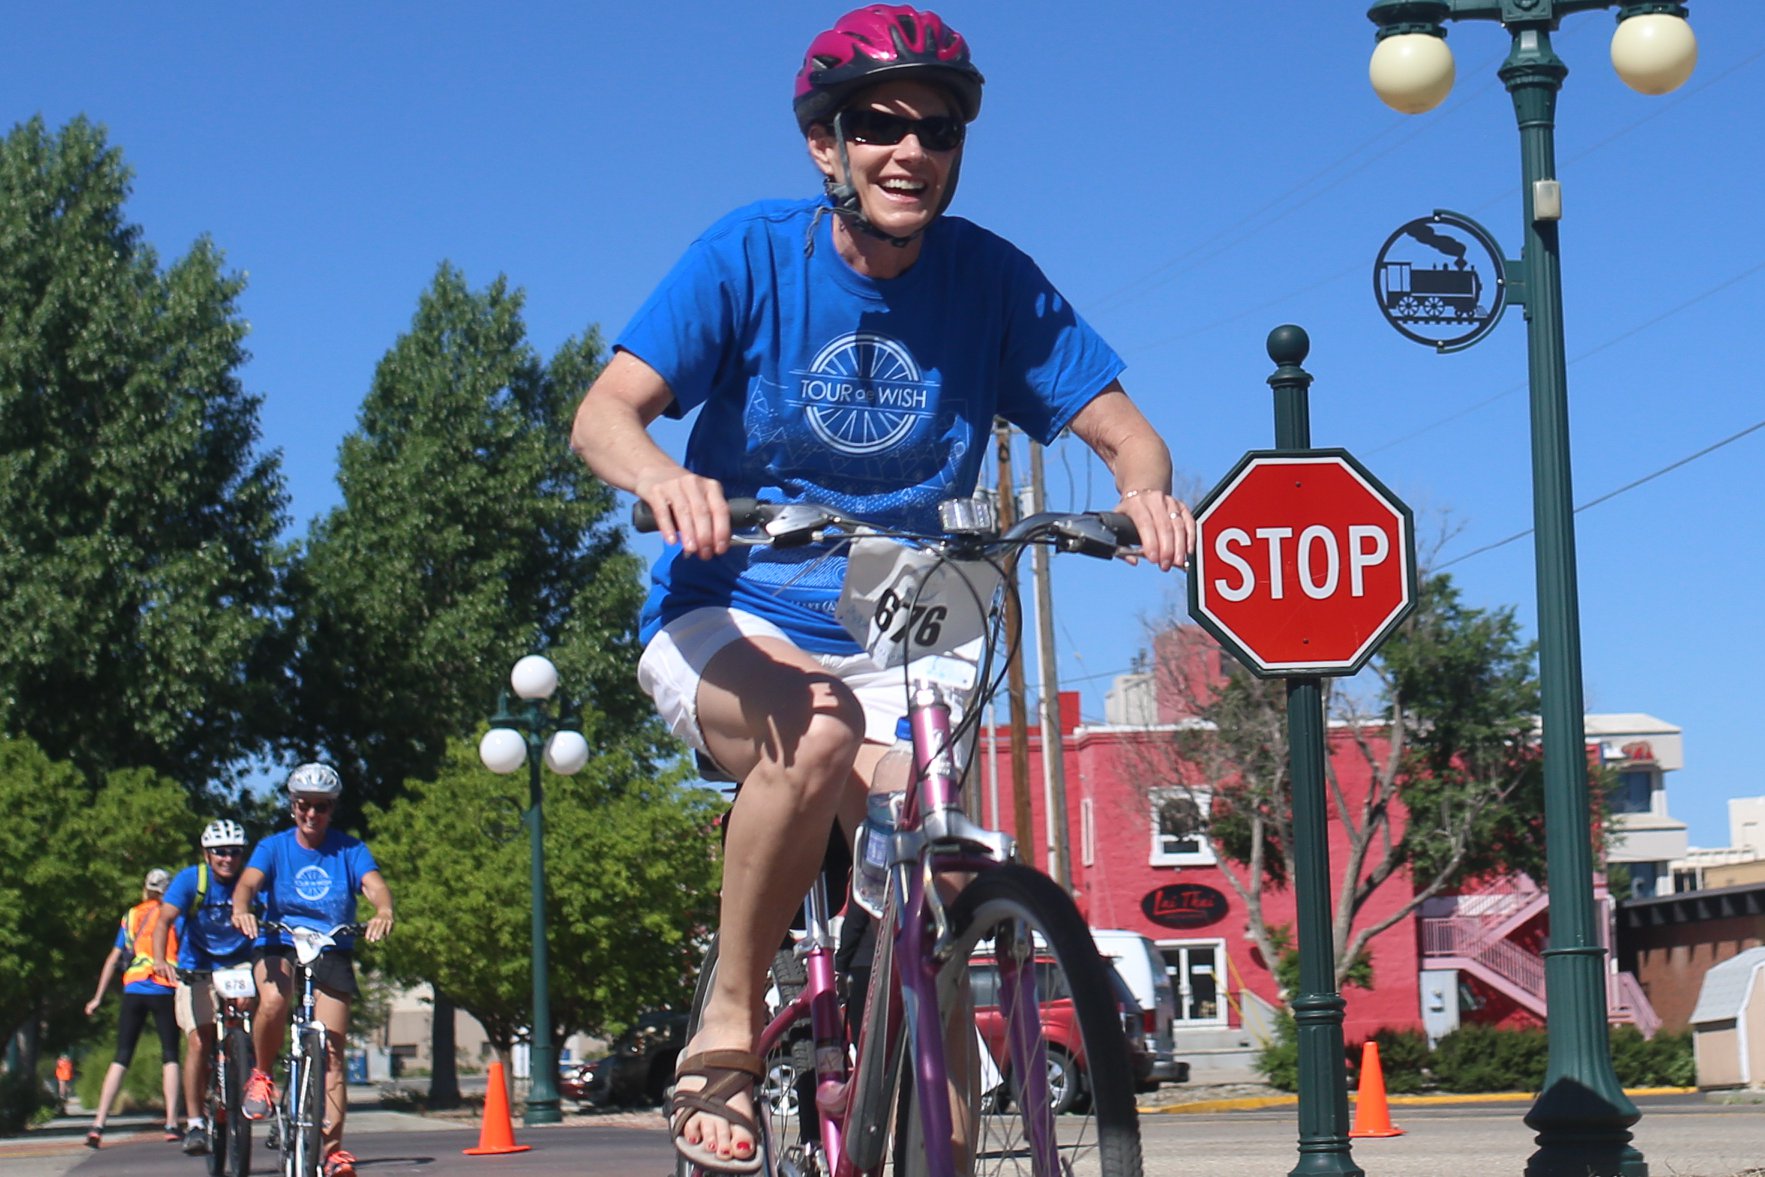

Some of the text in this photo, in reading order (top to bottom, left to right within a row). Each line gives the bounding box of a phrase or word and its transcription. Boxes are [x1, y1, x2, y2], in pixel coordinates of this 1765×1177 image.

[801, 380, 852, 402] TOUR
[878, 387, 927, 408] WISH
[1214, 524, 1390, 602] STOP
[875, 587, 948, 647] 676
